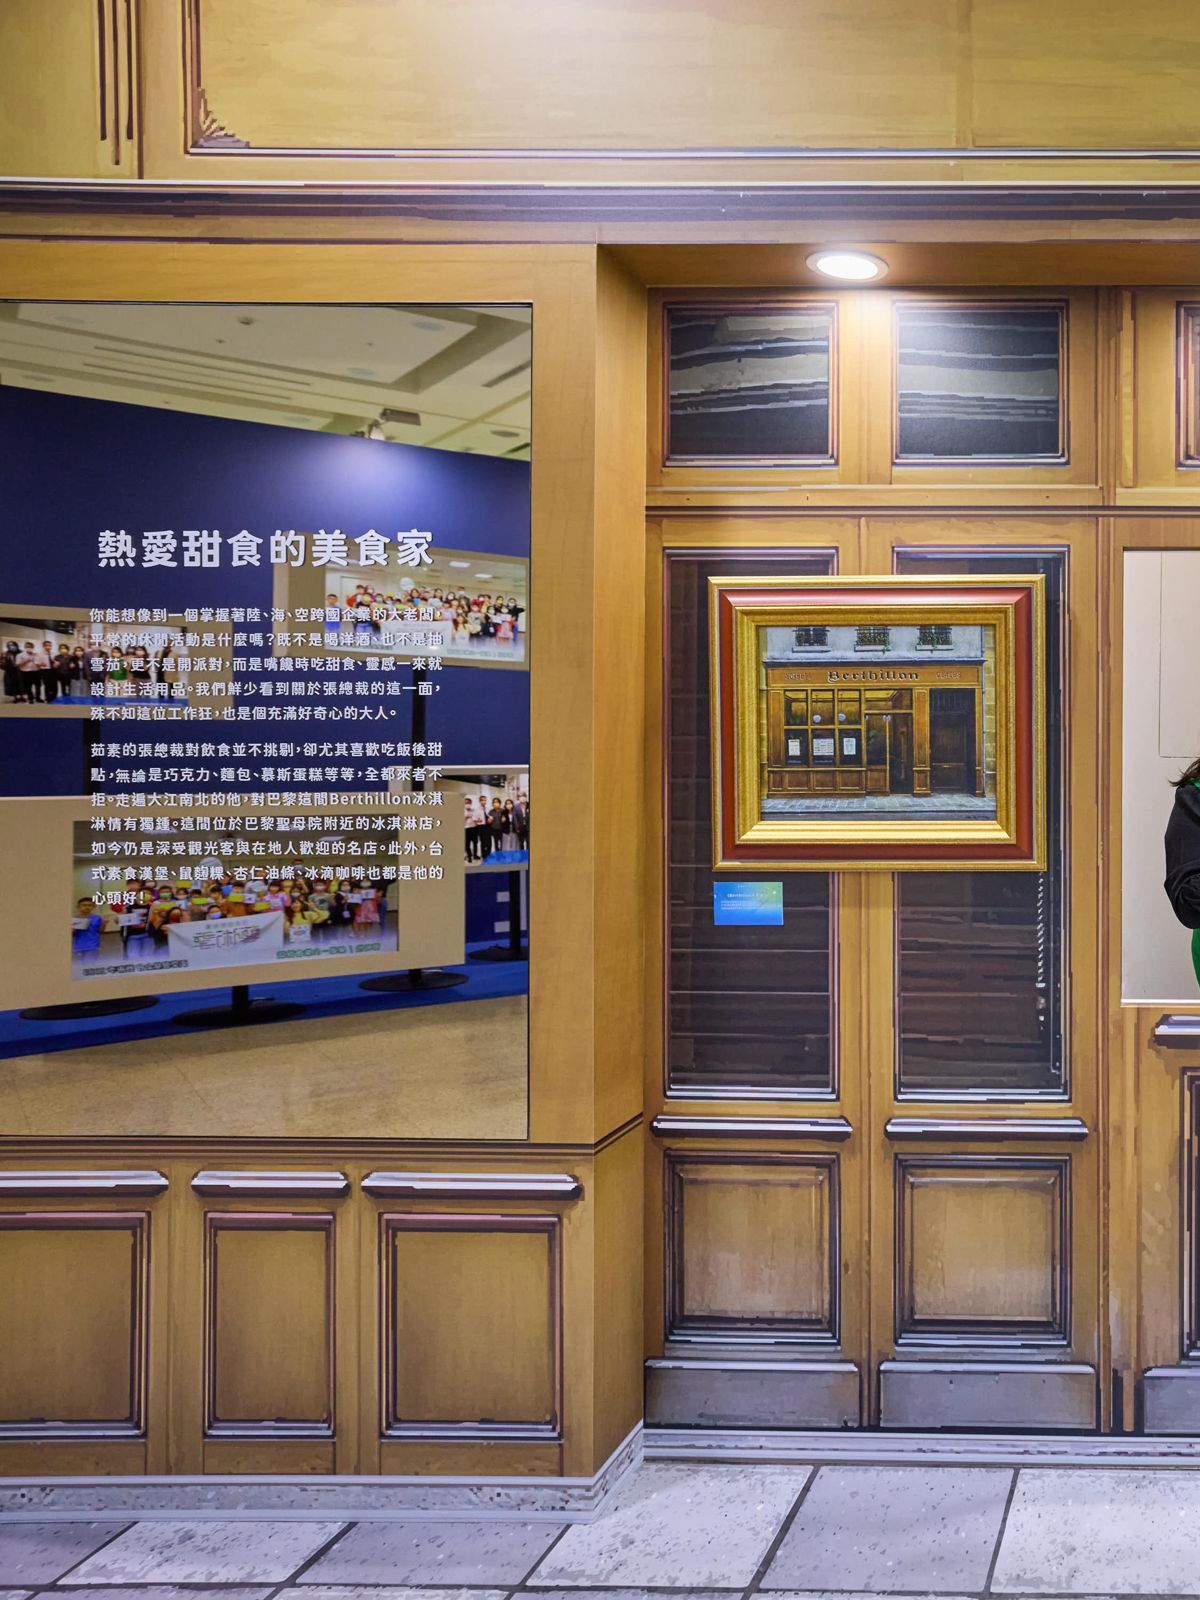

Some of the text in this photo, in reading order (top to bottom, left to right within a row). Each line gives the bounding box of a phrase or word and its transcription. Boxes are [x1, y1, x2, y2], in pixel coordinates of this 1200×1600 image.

[98, 529, 433, 568] 熱愛甜食的美食家
[827, 670, 920, 684] Berthillon
[92, 891, 145, 906] 心頭好！
